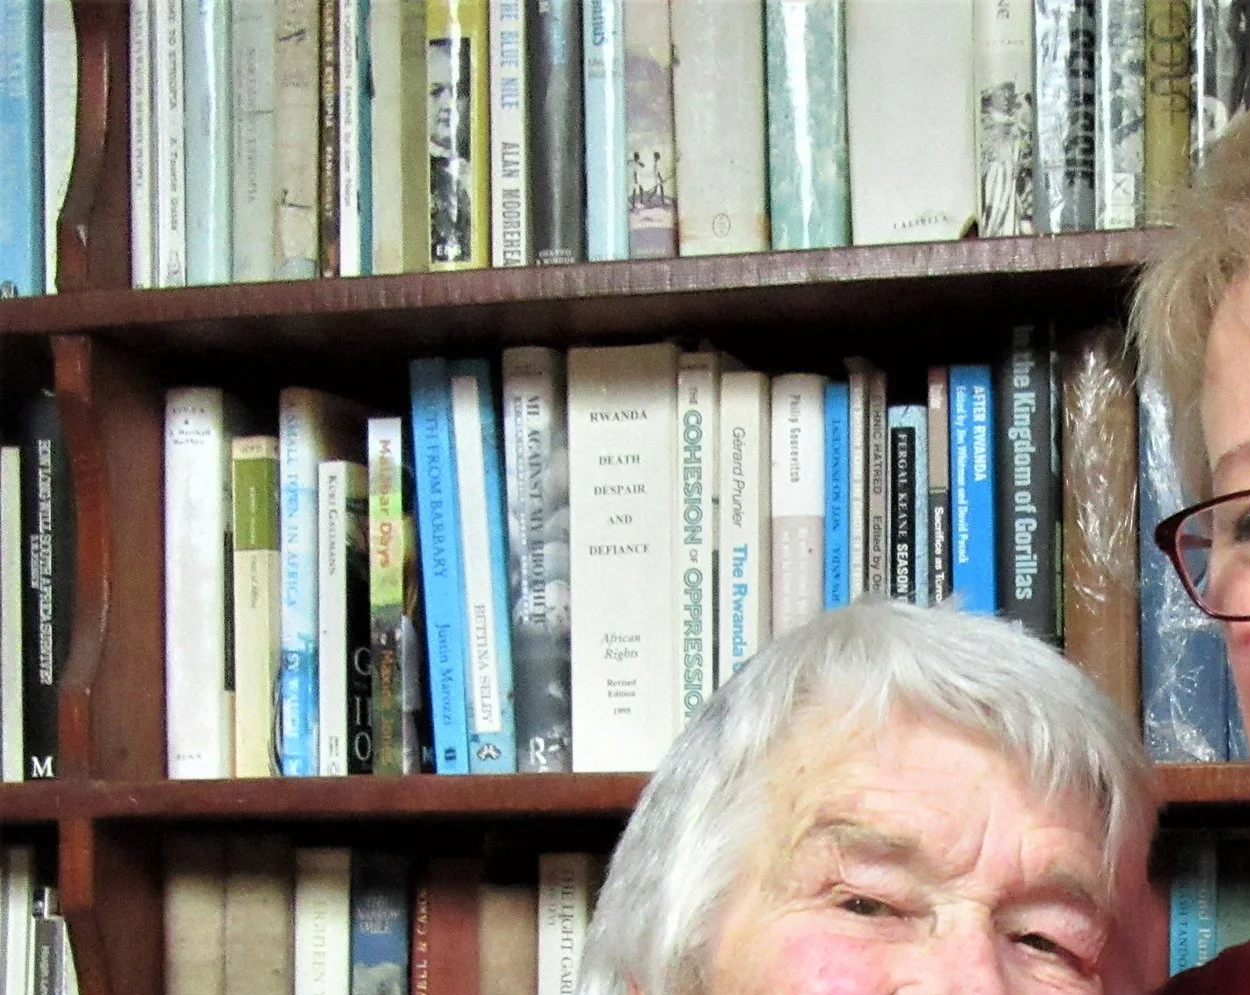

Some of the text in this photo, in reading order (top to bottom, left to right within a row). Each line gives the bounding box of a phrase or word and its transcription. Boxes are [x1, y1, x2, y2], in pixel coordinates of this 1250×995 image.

[501, 31, 521, 266] BLUE NILE ALAN MOOREHEA
[589, 409, 648, 423] RWANDA
[689, 386, 699, 405] THE
[956, 386, 968, 412] Edited
[287, 413, 299, 464] SMALL
[787, 394, 802, 484] Philip Gourevitch
[953, 413, 968, 426] by
[973, 386, 987, 482] AFTER RWANDA
[527, 427, 544, 500] AGAINST
[598, 452, 641, 466] DEATH
[732, 426, 746, 476] Gérard
[872, 443, 883, 496] HATRED
[287, 474, 299, 518] TOWN
[593, 482, 646, 496] DESPAIR
[683, 409, 703, 545] COHESION
[958, 485, 969, 505] and
[1008, 353, 1038, 600] the Kingdom of Gorillas
[425, 445, 448, 579] FROM BARBARY
[530, 507, 545, 534] MY
[606, 513, 633, 526] AND
[731, 478, 746, 529] Prunier
[896, 432, 909, 593] FERGAL KEANE SEASON
[958, 506, 970, 532] David
[287, 525, 299, 543] IN
[376, 522, 393, 569] Days
[588, 543, 651, 556] DEFIANCE
[689, 549, 699, 563] OF
[871, 515, 883, 554] Edited
[933, 506, 945, 570] Sacrifice as
[38, 440, 53, 685] HOW LONG WILL SOUTH AFRICA SURVIVE?
[287, 552, 299, 606] AFRICA
[530, 539, 549, 626] BROTHER
[732, 543, 749, 578] The
[868, 555, 883, 571] by
[600, 632, 642, 646] African
[732, 583, 749, 658] Rwanda
[434, 623, 456, 727] Justin Marozzi
[473, 604, 495, 724] BETTINA SELBY
[604, 645, 640, 662] Rights
[606, 677, 638, 688] Revised
[606, 689, 637, 699] Edition
[32, 756, 54, 778] M
[555, 914, 574, 960] LIGHT
[1178, 922, 1190, 969] TANDO
[38, 945, 50, 979] Hugh
